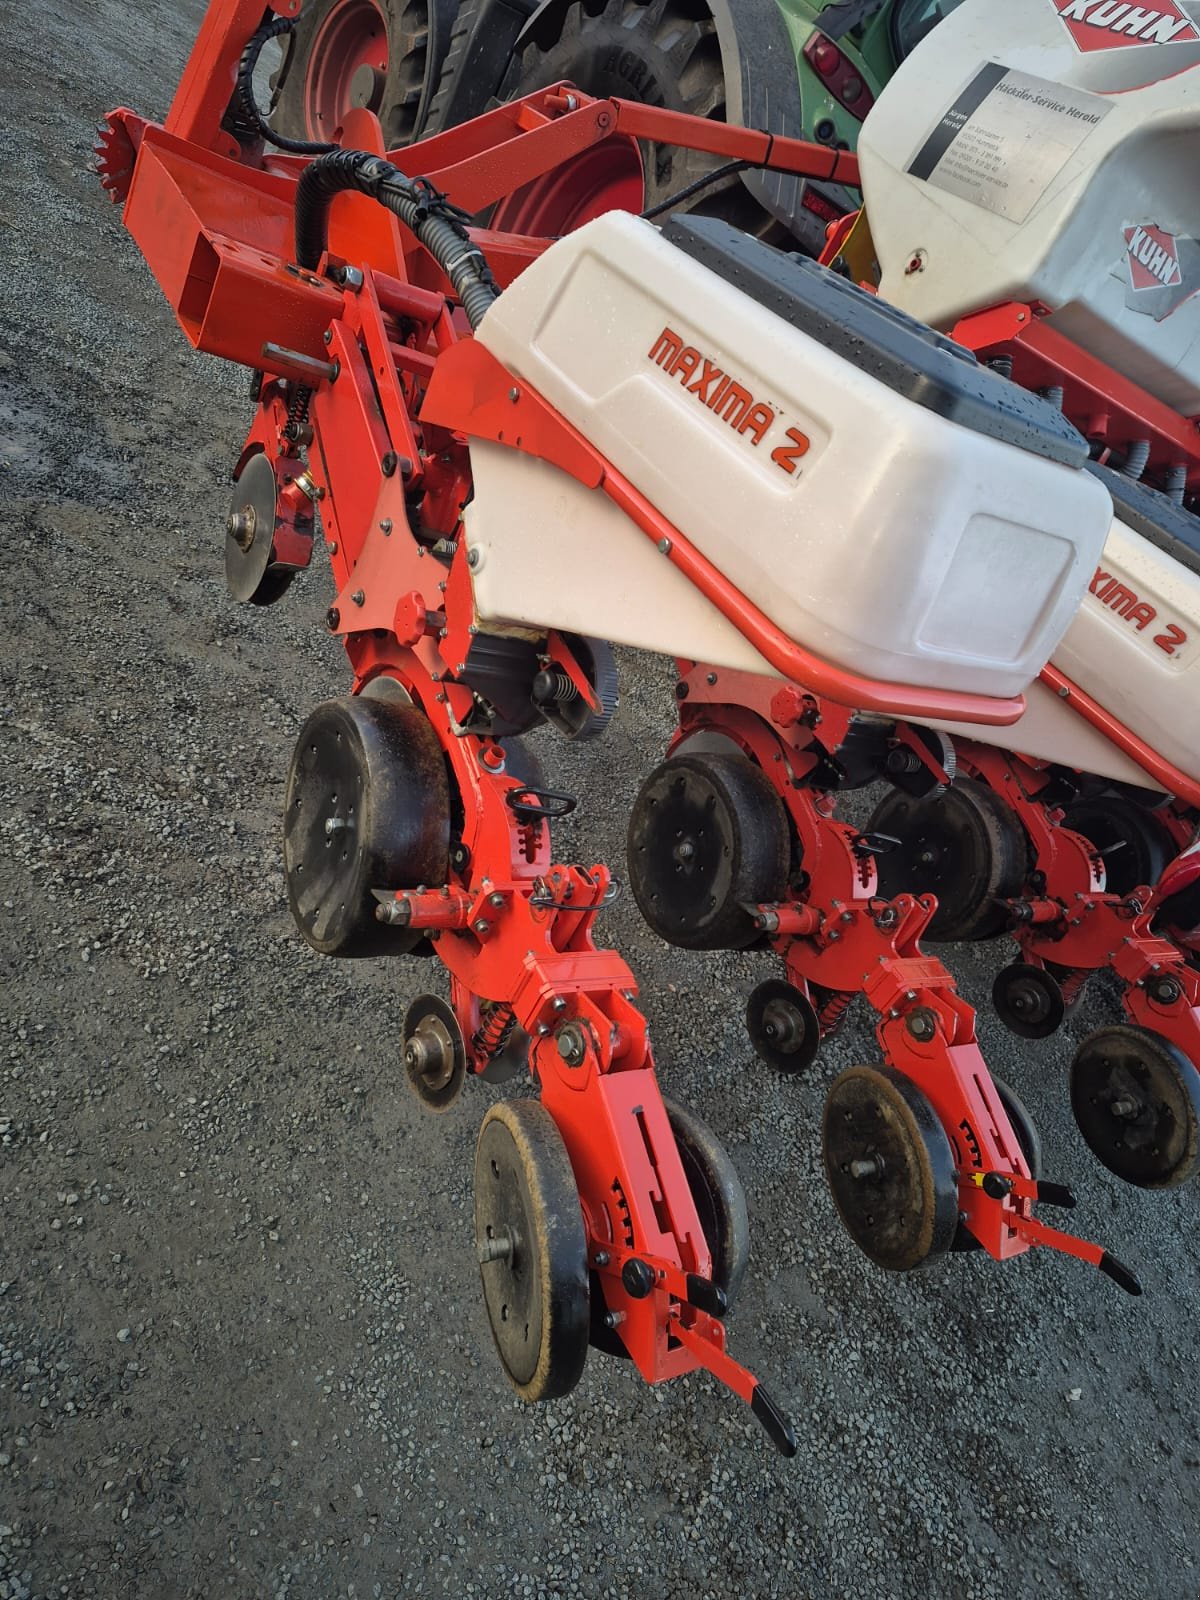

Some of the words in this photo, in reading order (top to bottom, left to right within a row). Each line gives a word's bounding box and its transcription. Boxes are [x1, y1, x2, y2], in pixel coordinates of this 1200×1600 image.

[1058, 0, 1192, 44] KUHN
[1065, 106, 1101, 124] Herold
[1127, 224, 1179, 286] KUHN
[648, 327, 775, 446] MAXIMA
[771, 427, 810, 474] 2
[1153, 623, 1187, 655] 2
